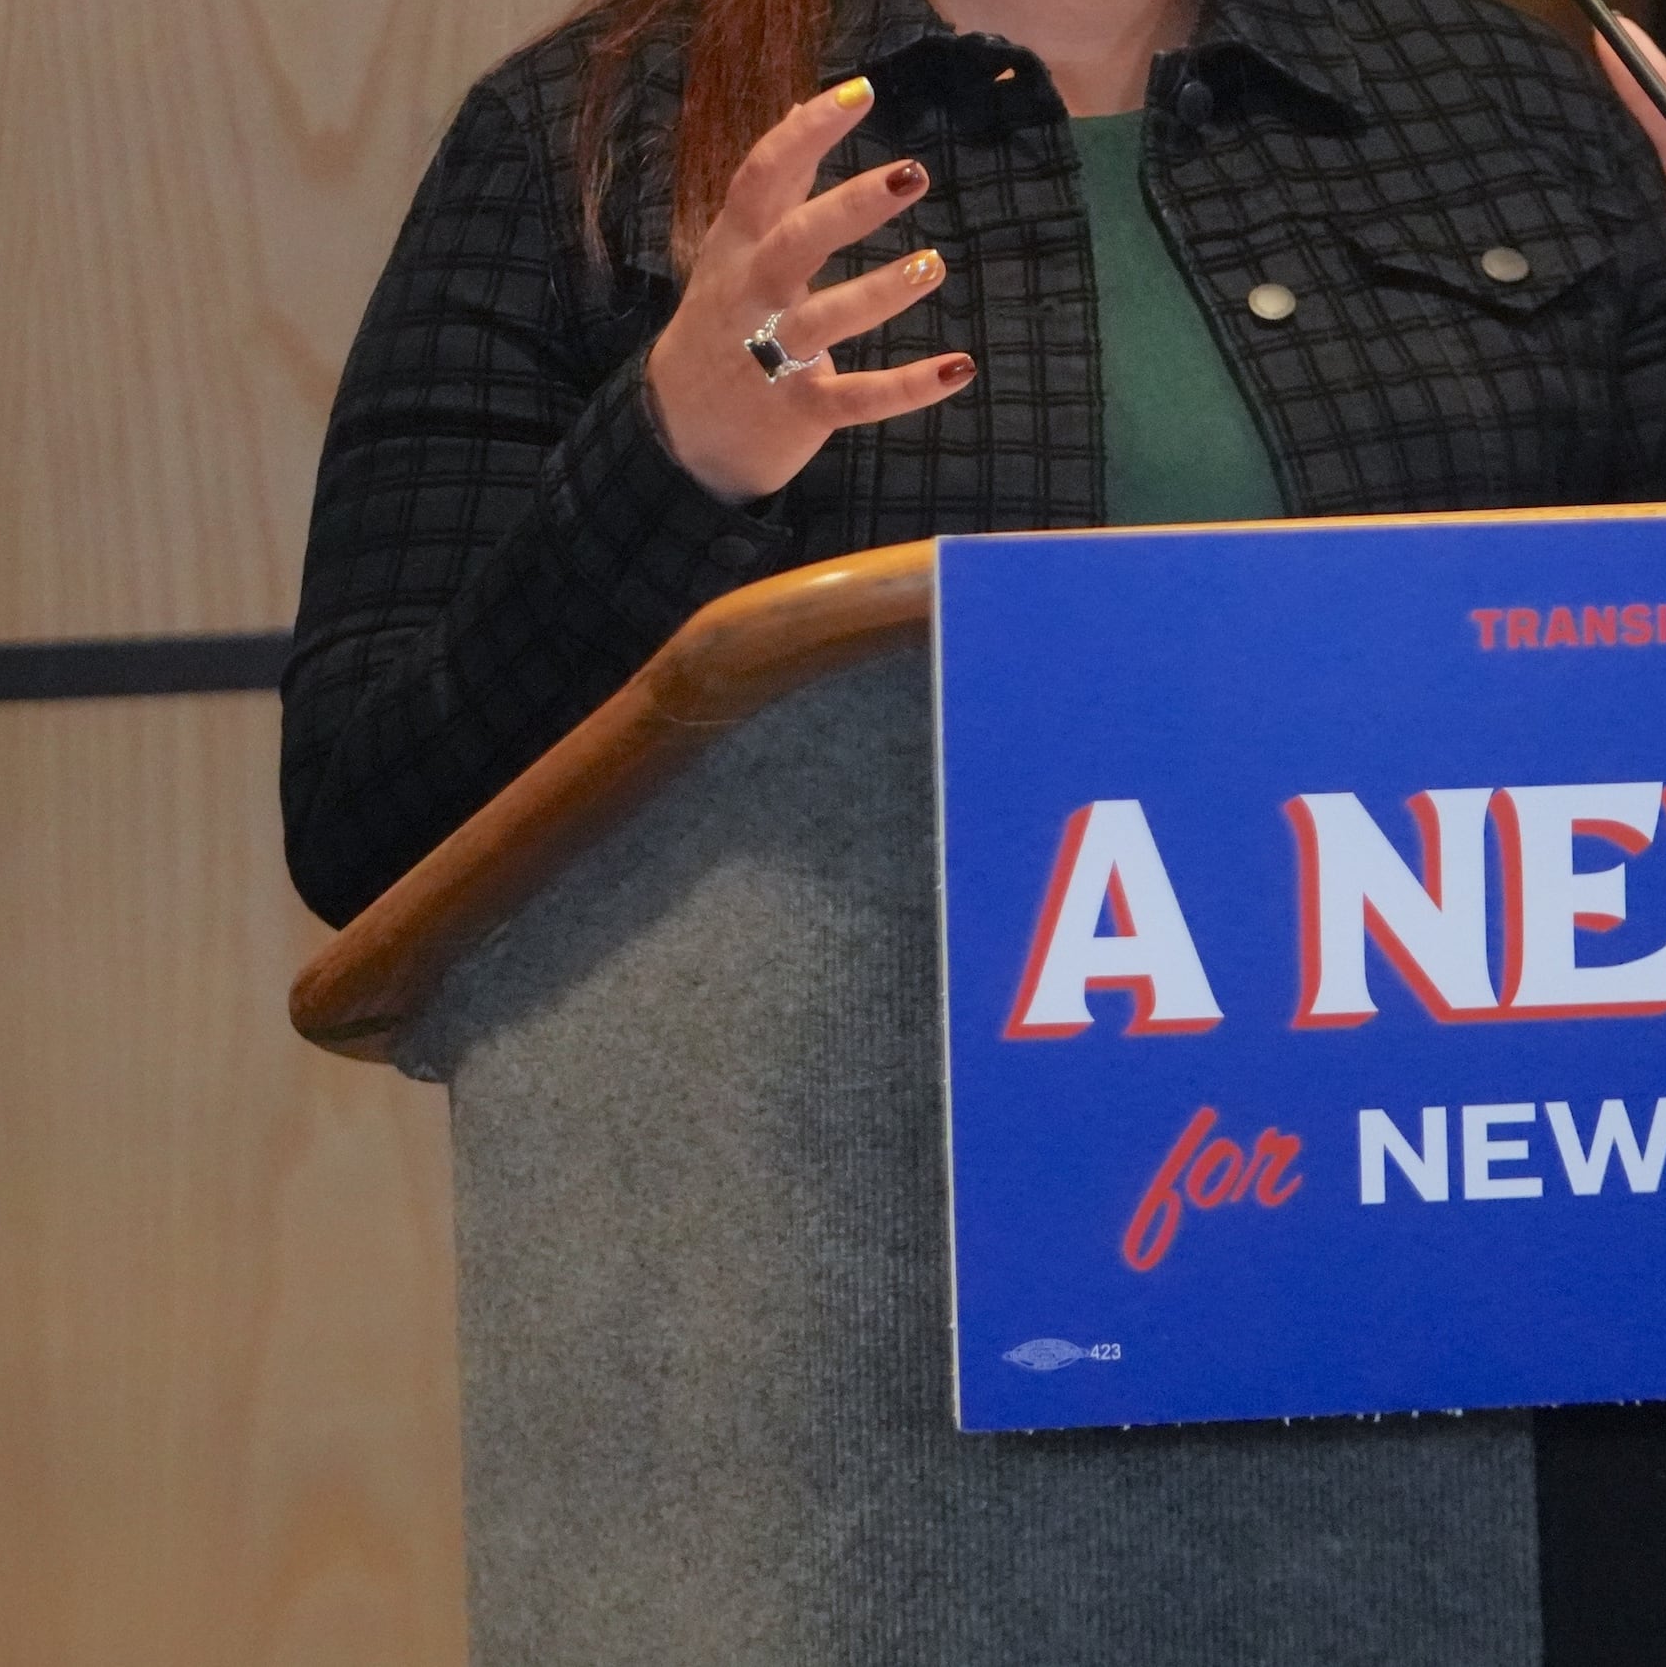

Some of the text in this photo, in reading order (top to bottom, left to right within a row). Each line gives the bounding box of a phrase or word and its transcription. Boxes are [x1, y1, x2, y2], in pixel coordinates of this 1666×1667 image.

[1003, 798, 1226, 1041] A
[1122, 1105, 1302, 1273] for
[1090, 1343, 1121, 1360] 423
